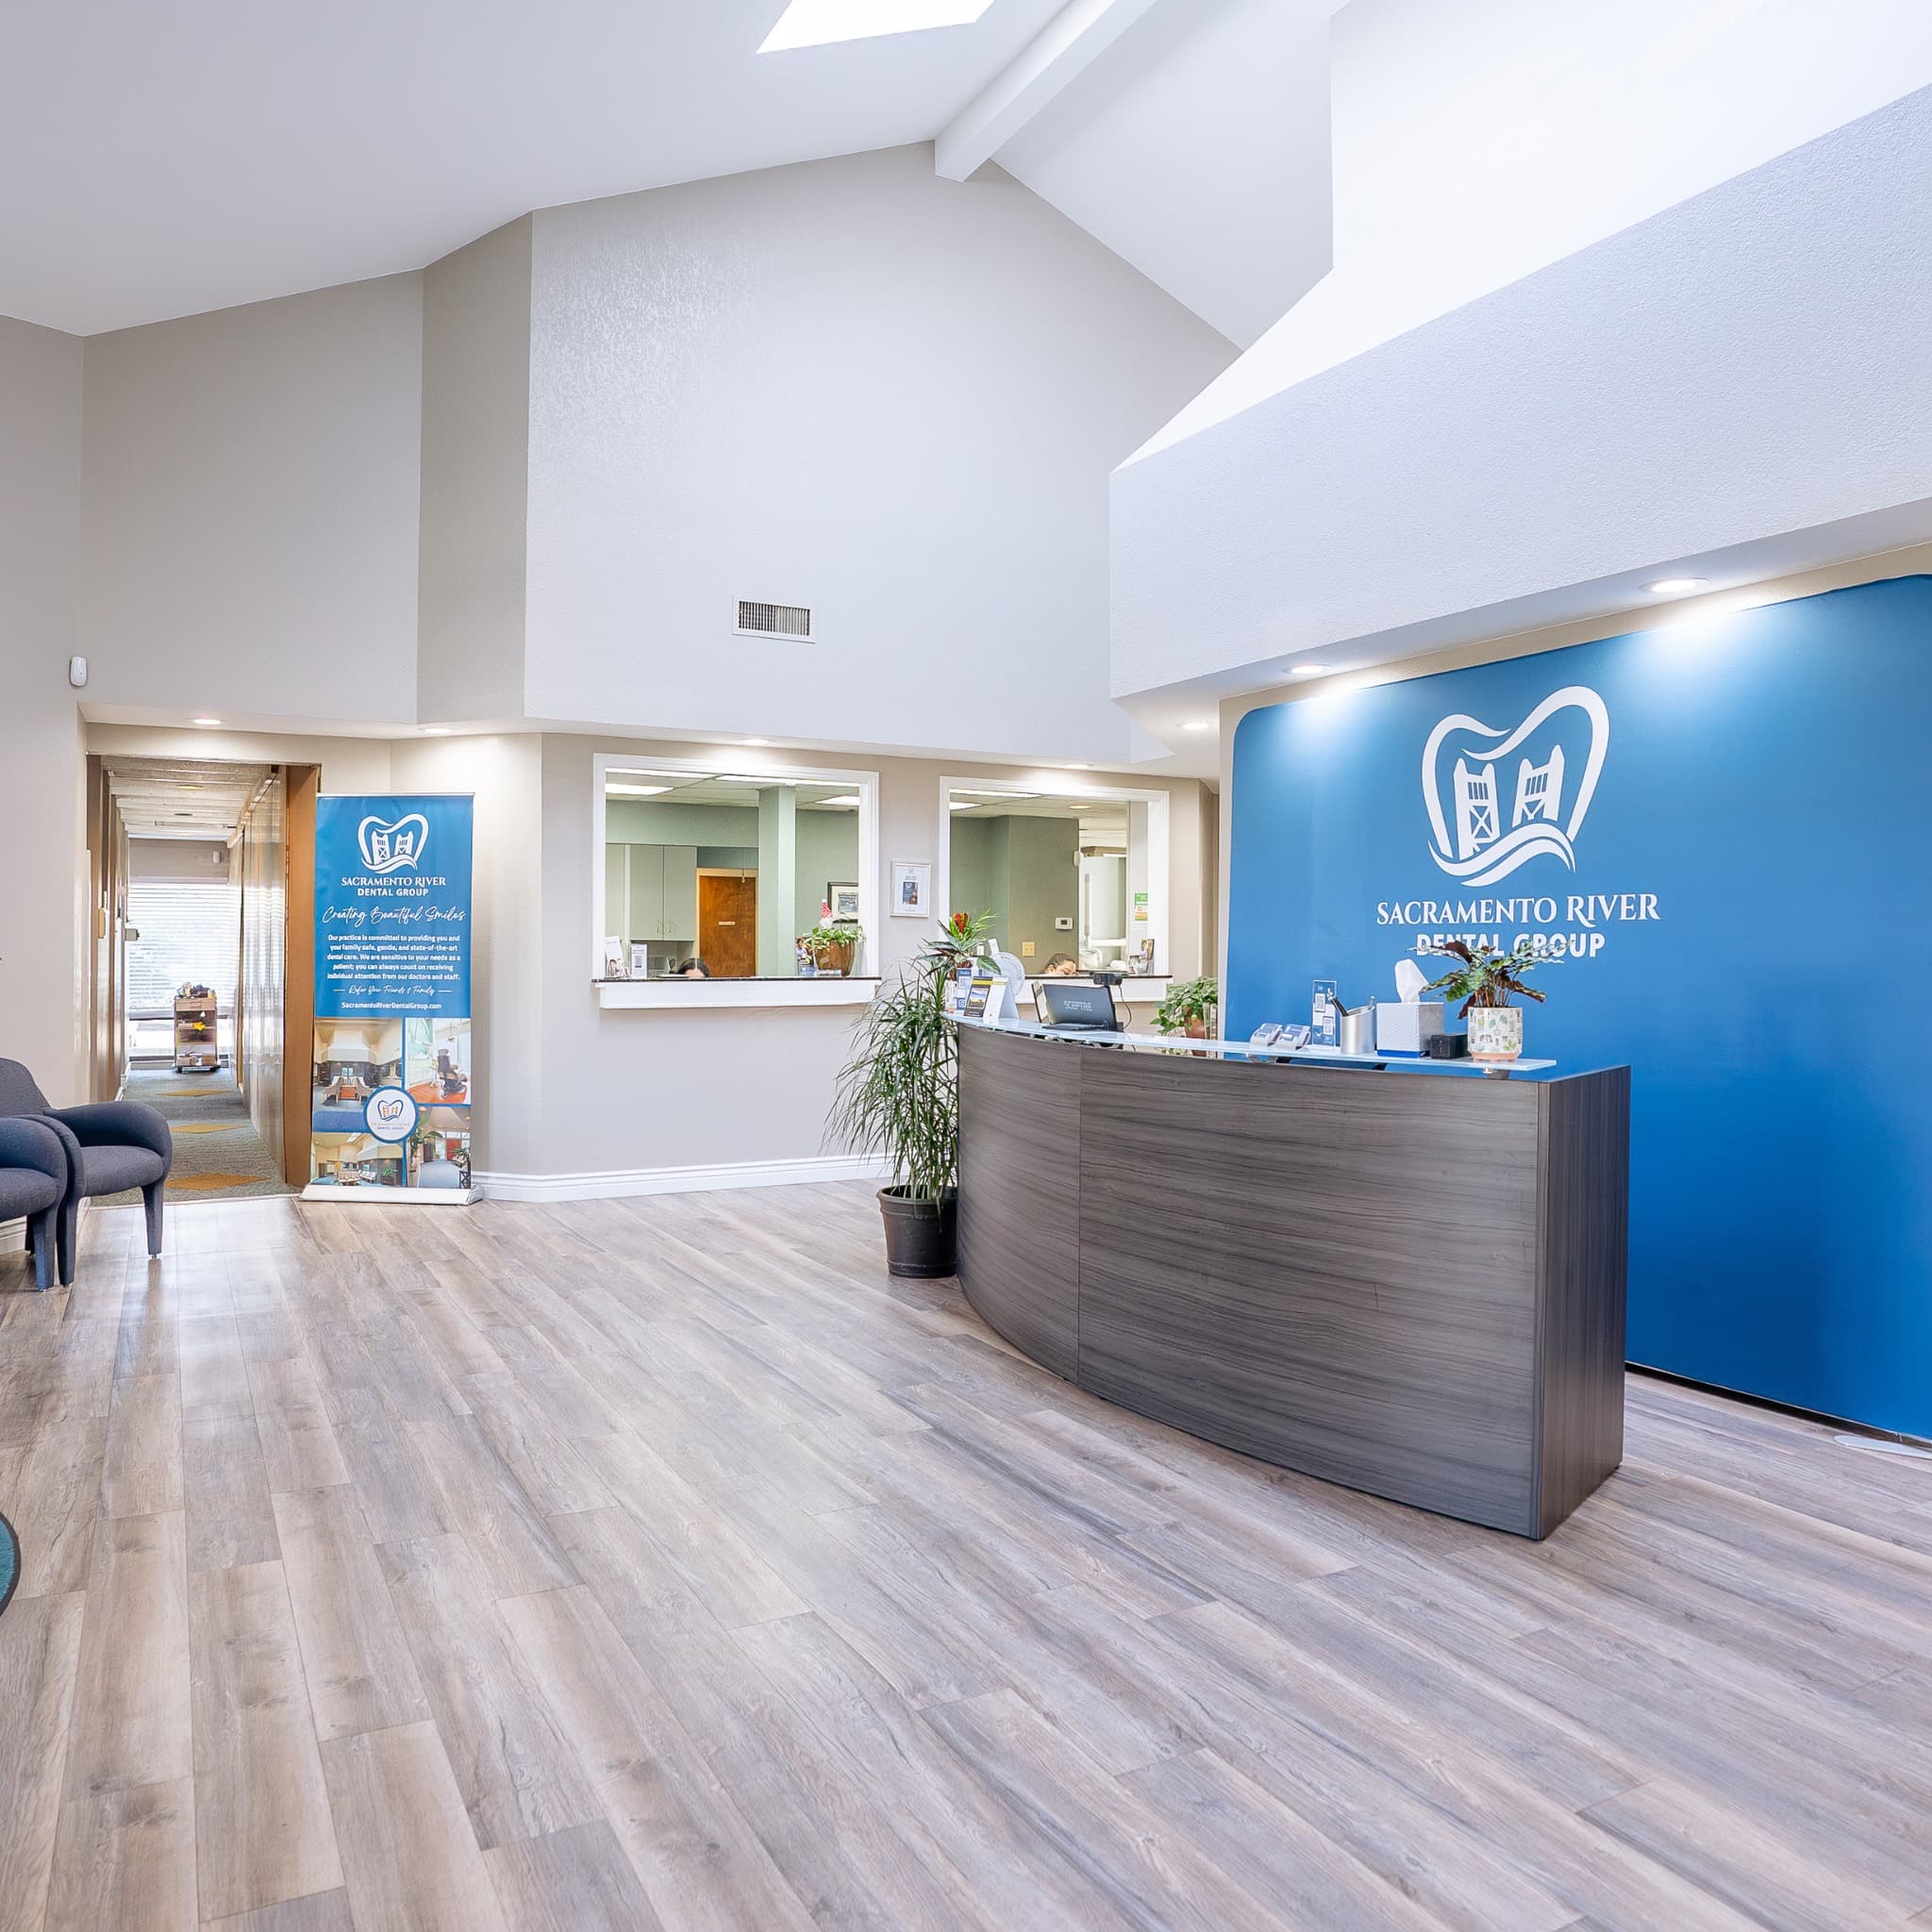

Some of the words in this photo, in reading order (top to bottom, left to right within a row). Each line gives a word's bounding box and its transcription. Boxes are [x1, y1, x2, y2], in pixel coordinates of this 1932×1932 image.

[341, 877, 412, 886] SACRAMENTO
[415, 877, 446, 887] RIVER
[322, 906, 367, 927] Creating
[370, 905, 423, 924] Beautiful
[425, 905, 466, 922] Smiles
[1376, 897, 1558, 925] SACRAMENTO
[1566, 893, 1660, 927] RIVER
